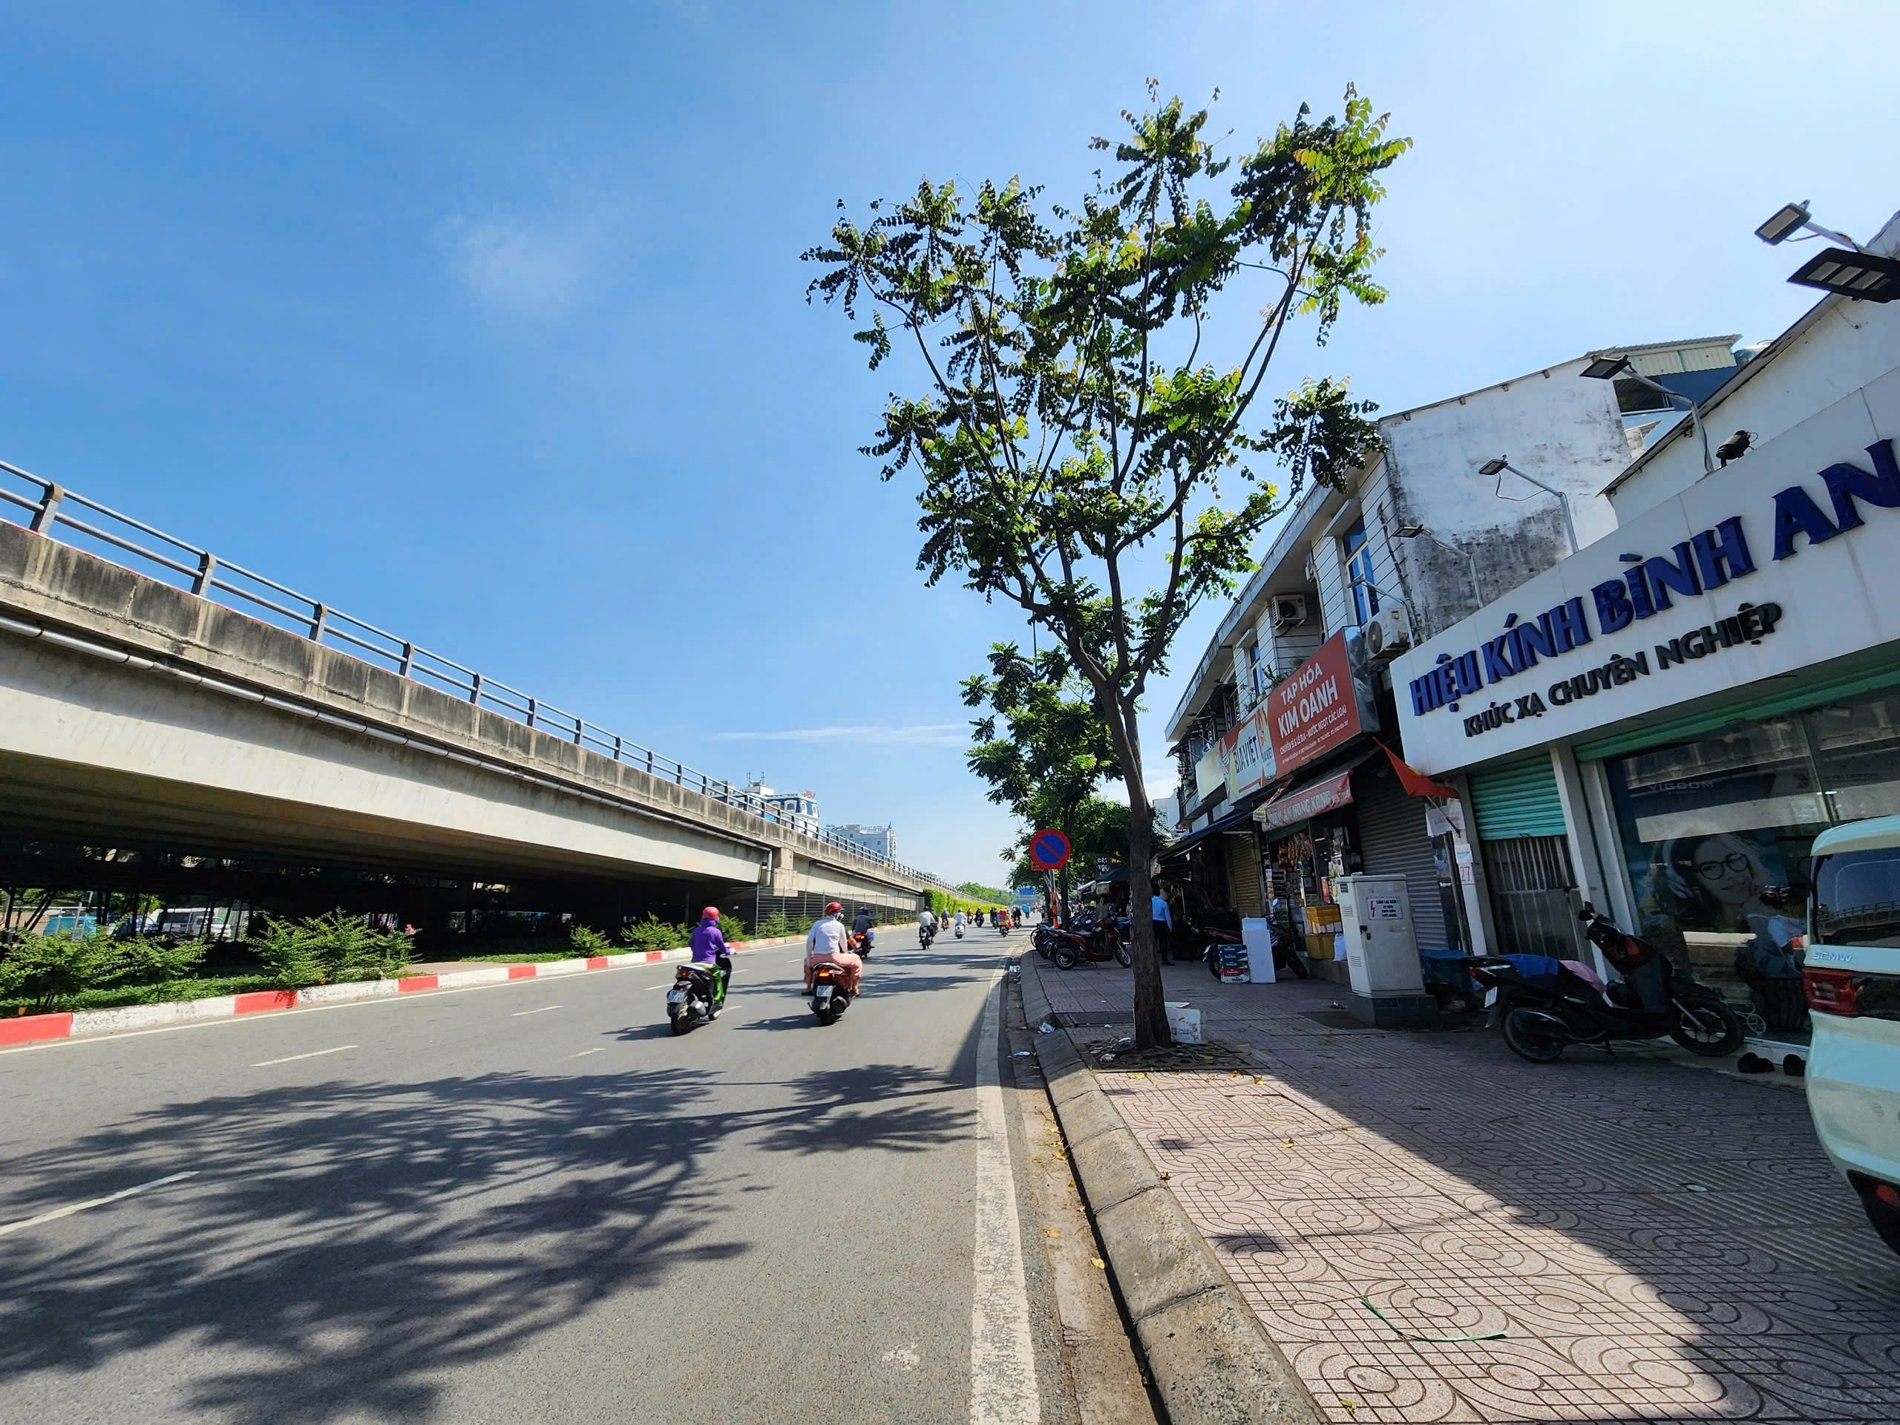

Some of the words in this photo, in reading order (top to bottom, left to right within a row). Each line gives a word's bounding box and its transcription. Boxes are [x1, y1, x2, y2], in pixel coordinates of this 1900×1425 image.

[1409, 653, 1482, 714] HIỆU
[1481, 613, 1593, 684] KÍNH
[1591, 516, 1758, 635] BÌNH
[1772, 438, 1900, 561] AN
[1278, 705, 1300, 739] KIM
[1300, 675, 1339, 723] OANH
[1281, 682, 1298, 705] TẠP
[1299, 662, 1323, 691] HÓA
[1463, 694, 1515, 738] KHÚC
[1517, 686, 1548, 719] XẠ
[1548, 654, 1650, 706] CHUYÊN
[1654, 602, 1783, 670] NGHIỆP
